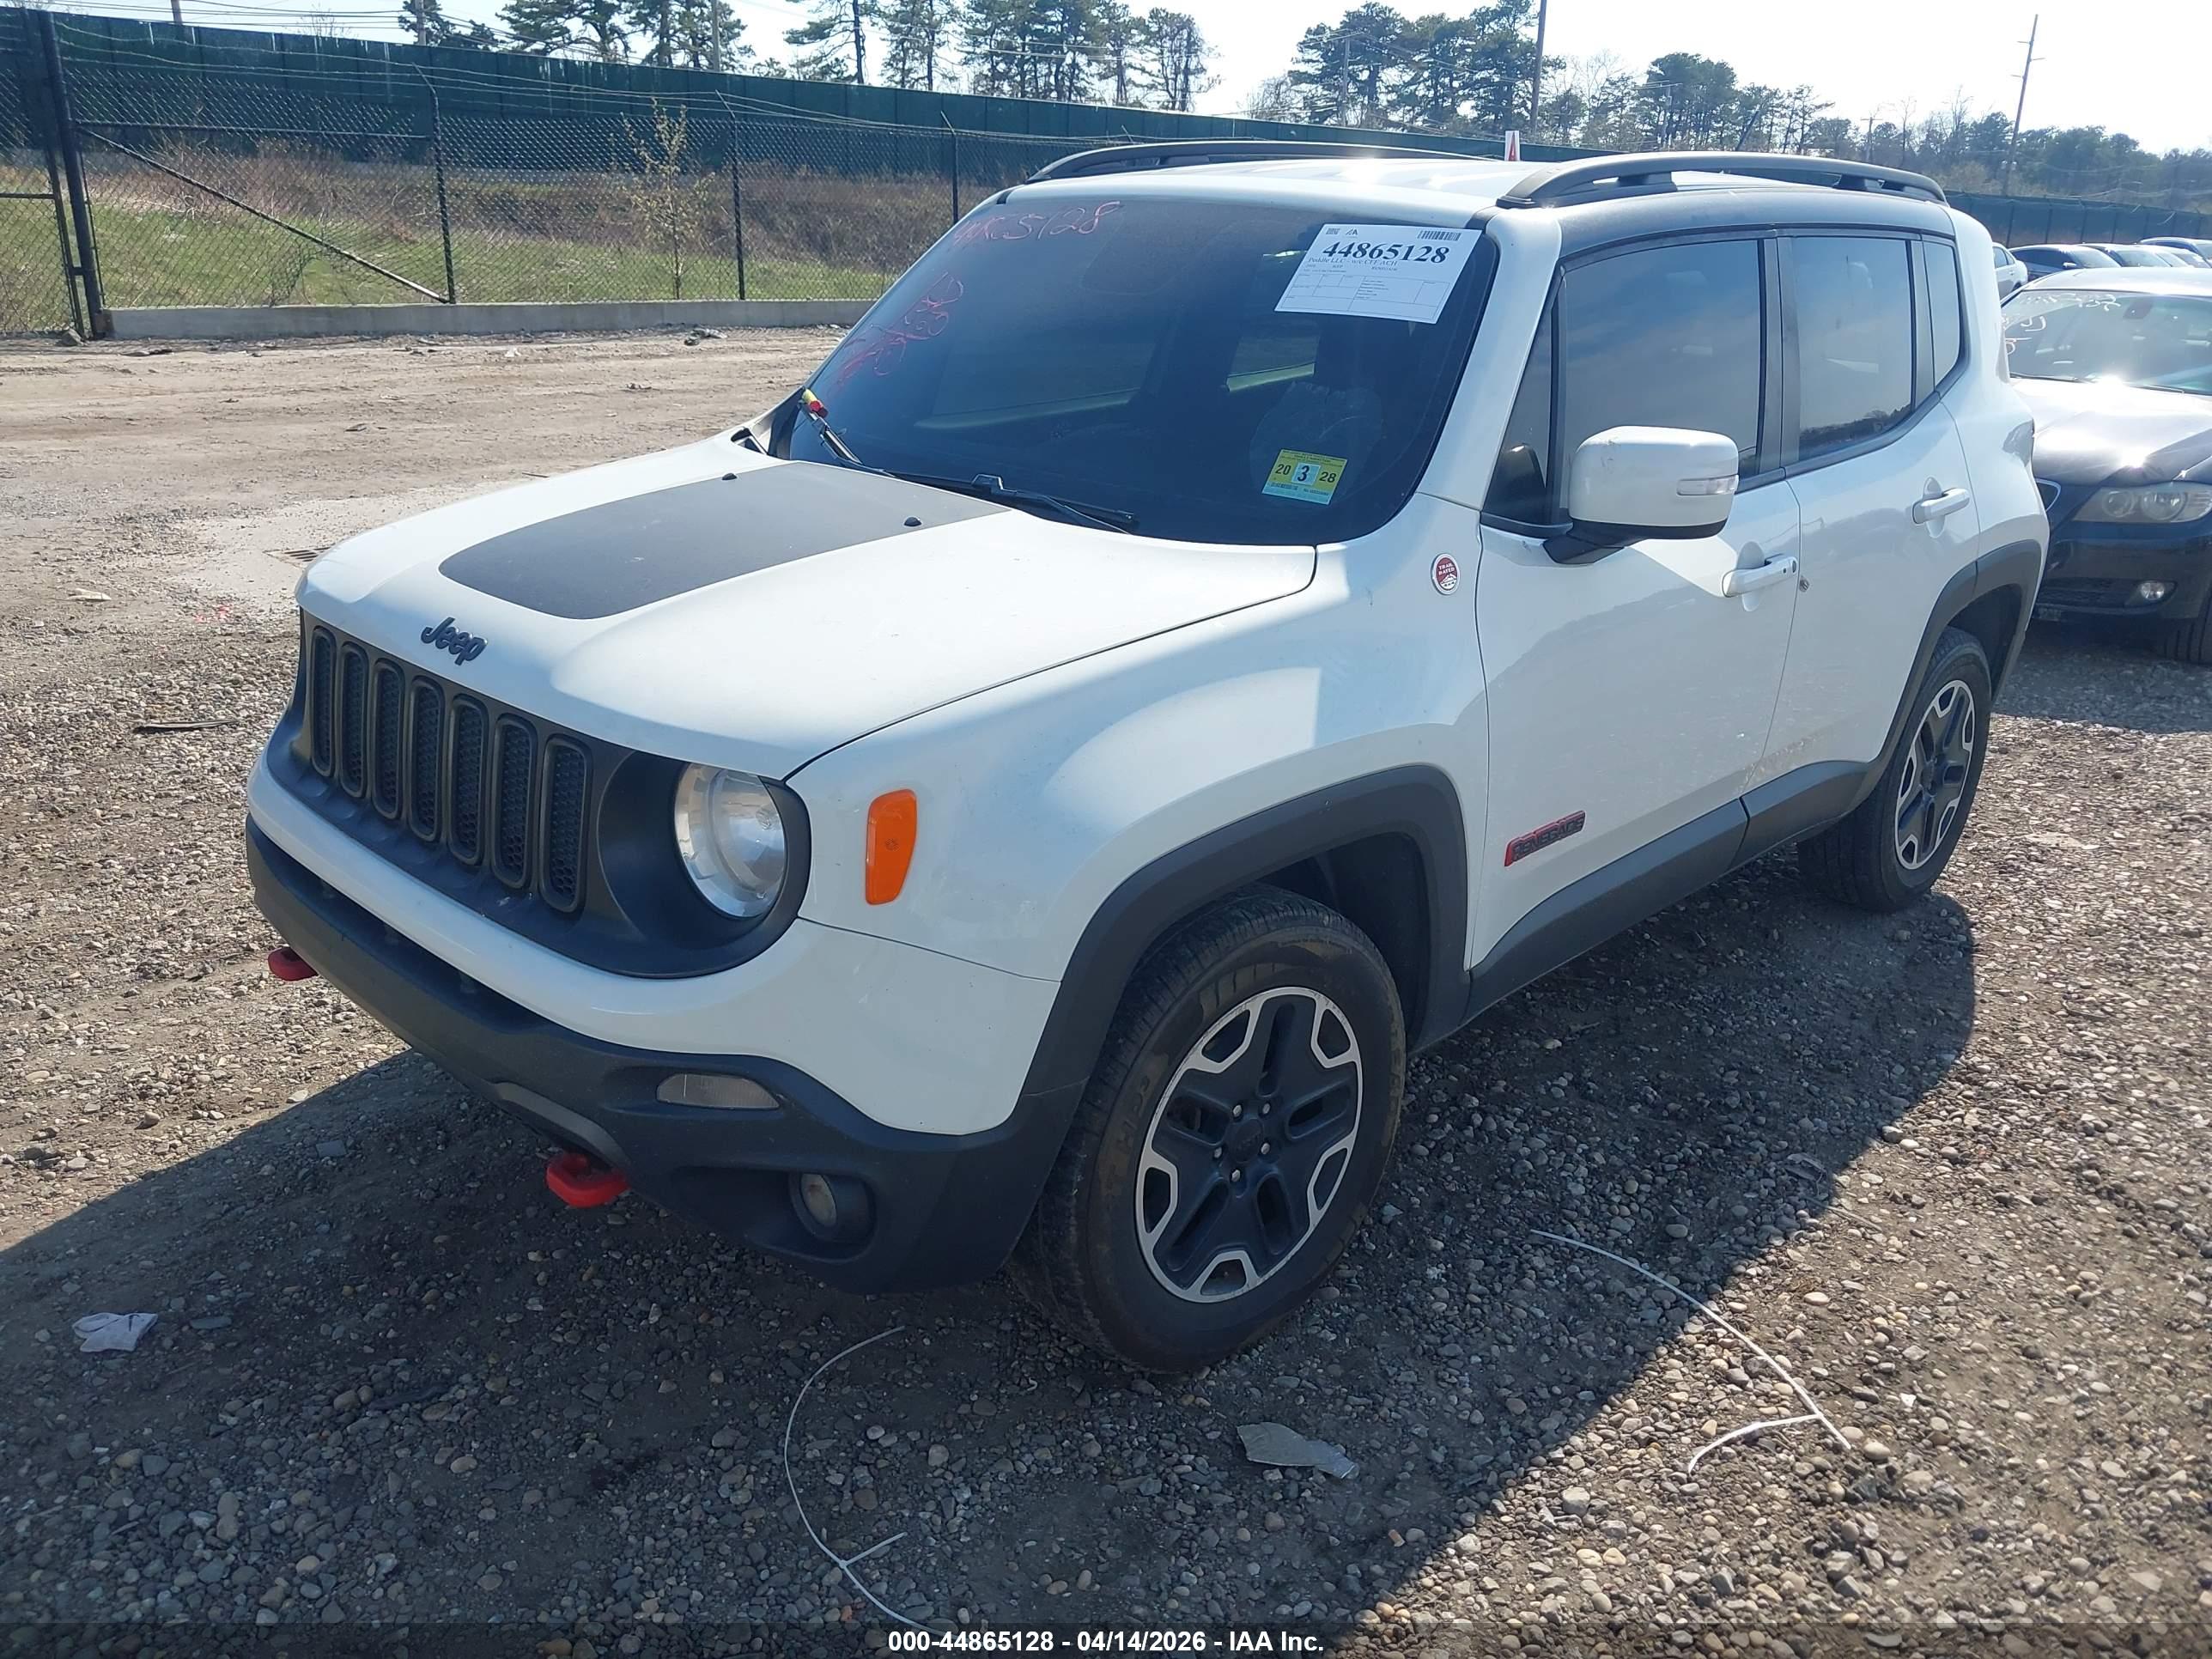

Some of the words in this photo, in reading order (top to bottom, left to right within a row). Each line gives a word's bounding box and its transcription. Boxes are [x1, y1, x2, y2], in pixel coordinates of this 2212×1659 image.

[1322, 241, 1450, 264] 44865128
[1275, 464, 1291, 476] 20
[1297, 465, 1310, 482] 3
[1319, 471, 1337, 483] 28
[1438, 567, 1455, 575] RATED
[421, 617, 487, 666] Jeep
